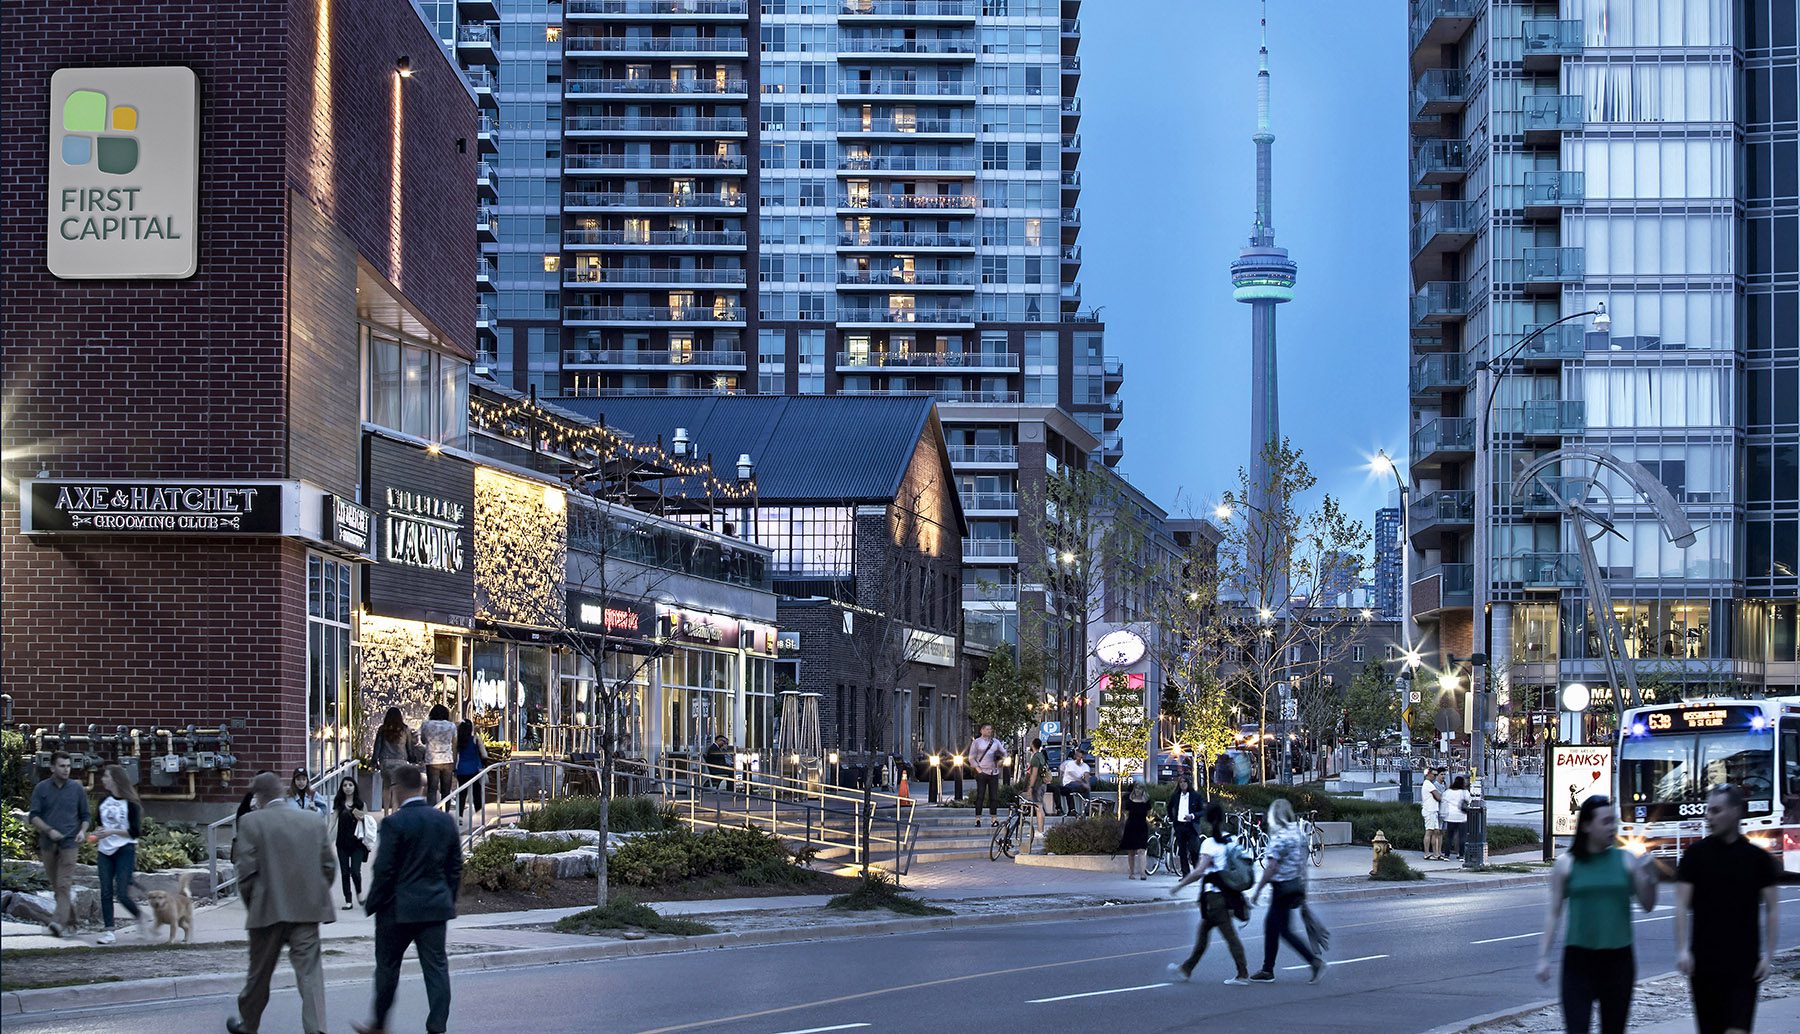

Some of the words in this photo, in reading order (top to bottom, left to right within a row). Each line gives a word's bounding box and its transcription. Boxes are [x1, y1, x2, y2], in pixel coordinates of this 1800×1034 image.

[61, 188, 141, 212] FIRST
[60, 216, 181, 241] CAPITAL
[93, 514, 176, 529] GROOMING
[178, 515, 219, 530] CLUB
[1557, 753, 1609, 767] BANKSY
